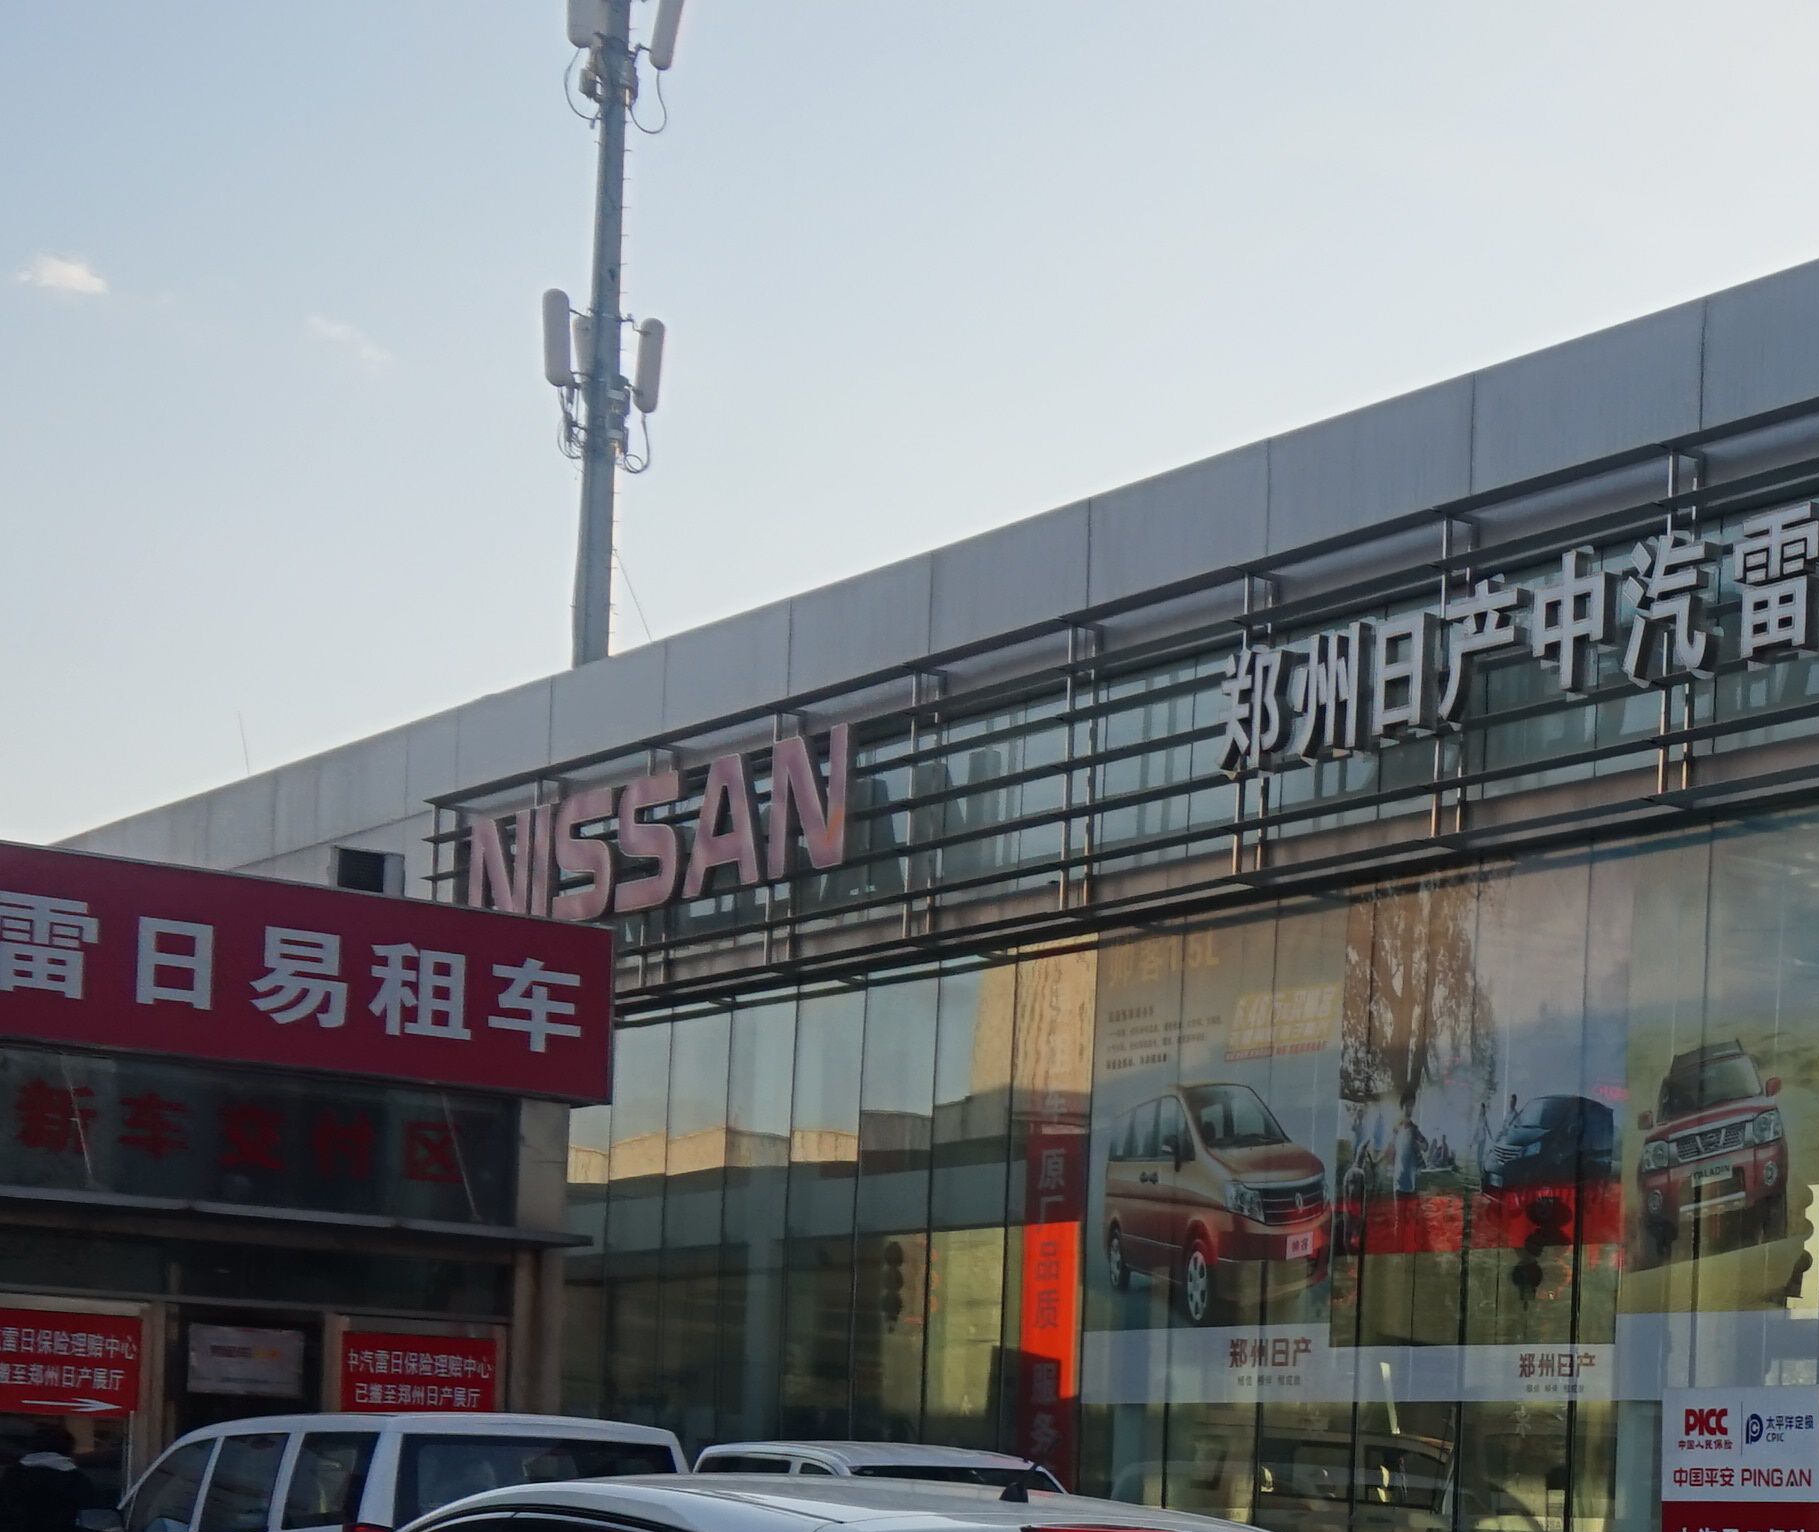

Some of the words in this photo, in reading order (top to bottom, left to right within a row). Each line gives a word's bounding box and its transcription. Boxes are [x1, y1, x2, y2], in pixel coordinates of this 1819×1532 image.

[468, 722, 856, 922] NISSAN
[0, 891, 581, 1053] 雷日易租车
[1229, 1336, 1313, 1368] 郑州日产
[1519, 1353, 1596, 1378] 郑州日产
[1684, 1408, 1728, 1436] PICC
[1678, 1439, 1733, 1450] 中国人民保险
[1766, 1432, 1784, 1442] CPIC
[1673, 1467, 1734, 1488] 中国平安
